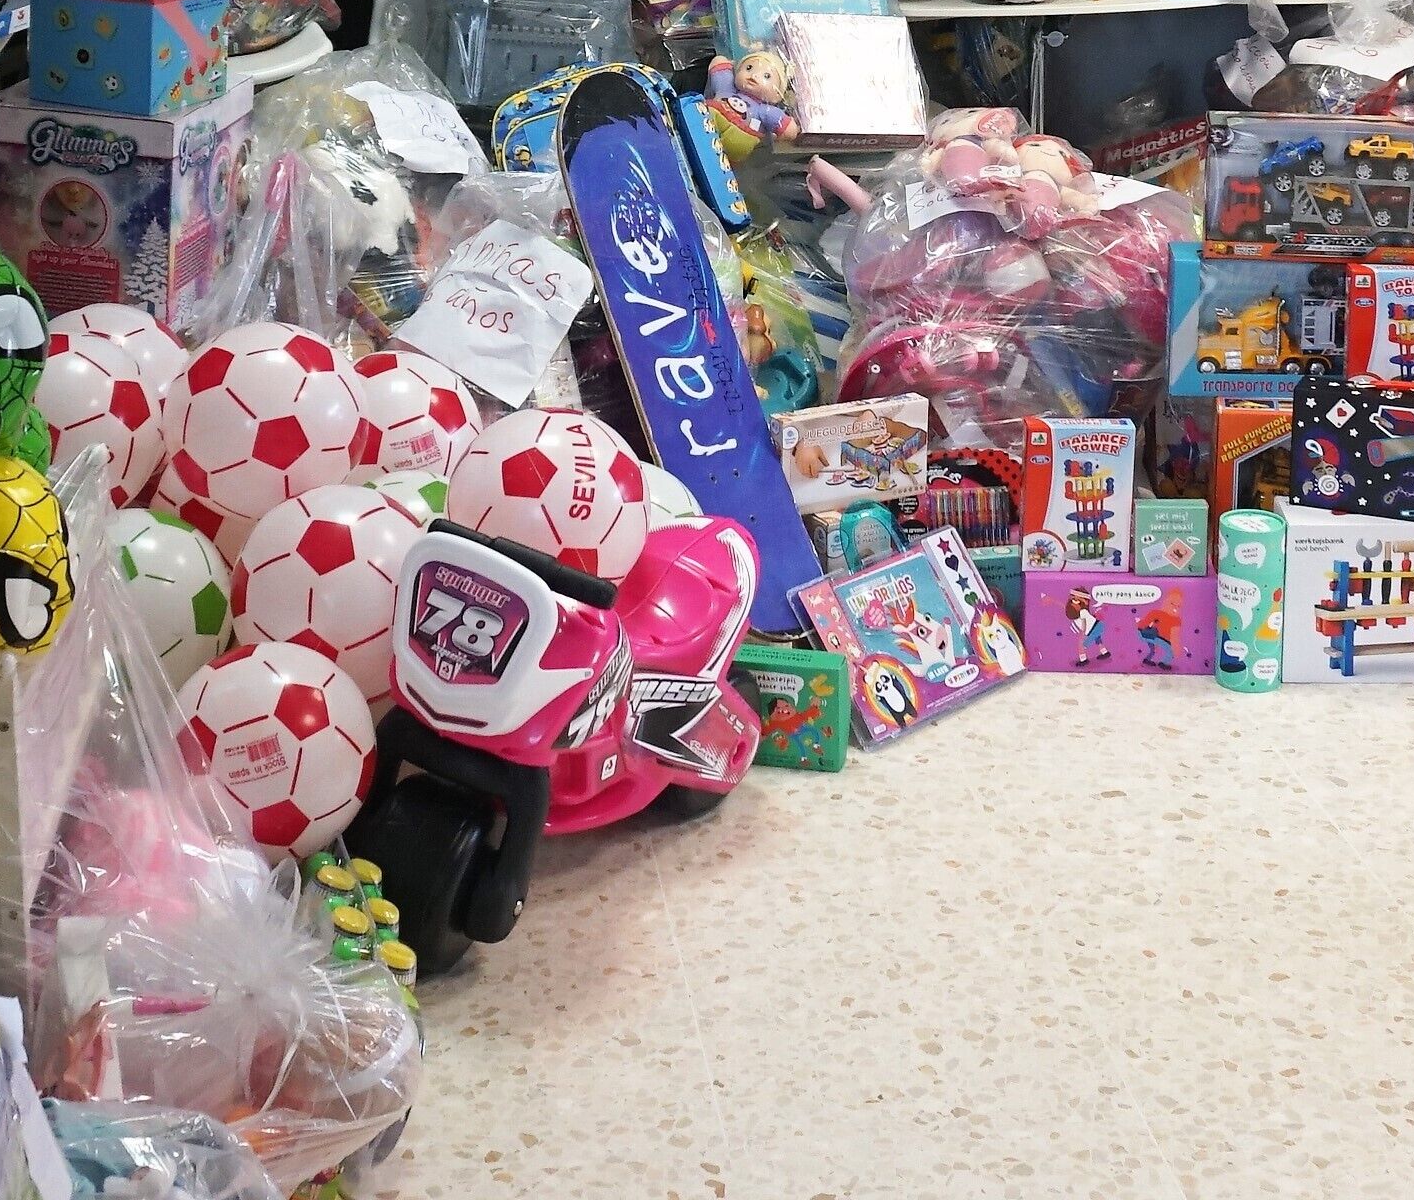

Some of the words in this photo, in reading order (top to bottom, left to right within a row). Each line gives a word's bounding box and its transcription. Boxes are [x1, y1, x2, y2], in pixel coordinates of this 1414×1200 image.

[29, 118, 136, 170] Glimmies
[826, 135, 881, 148] MEMO
[475, 239, 562, 309] niñas
[445, 283, 515, 337] años
[611, 228, 737, 459] rave
[805, 427, 838, 440] JUEGO
[1060, 433, 1130, 449] BALANCE
[1072, 443, 1121, 455] TOWER
[1221, 437, 1261, 463] REMOTE
[1260, 422, 1292, 447] CONTR
[1222, 433, 1246, 453] FULL
[1244, 415, 1289, 443] FUNCTION
[569, 423, 590, 521] SEVILLA
[1294, 544, 1309, 552] tool
[1309, 544, 1330, 552] bench
[435, 565, 512, 608] springer
[418, 587, 505, 658] 78
[262, 756, 287, 772] Stock
